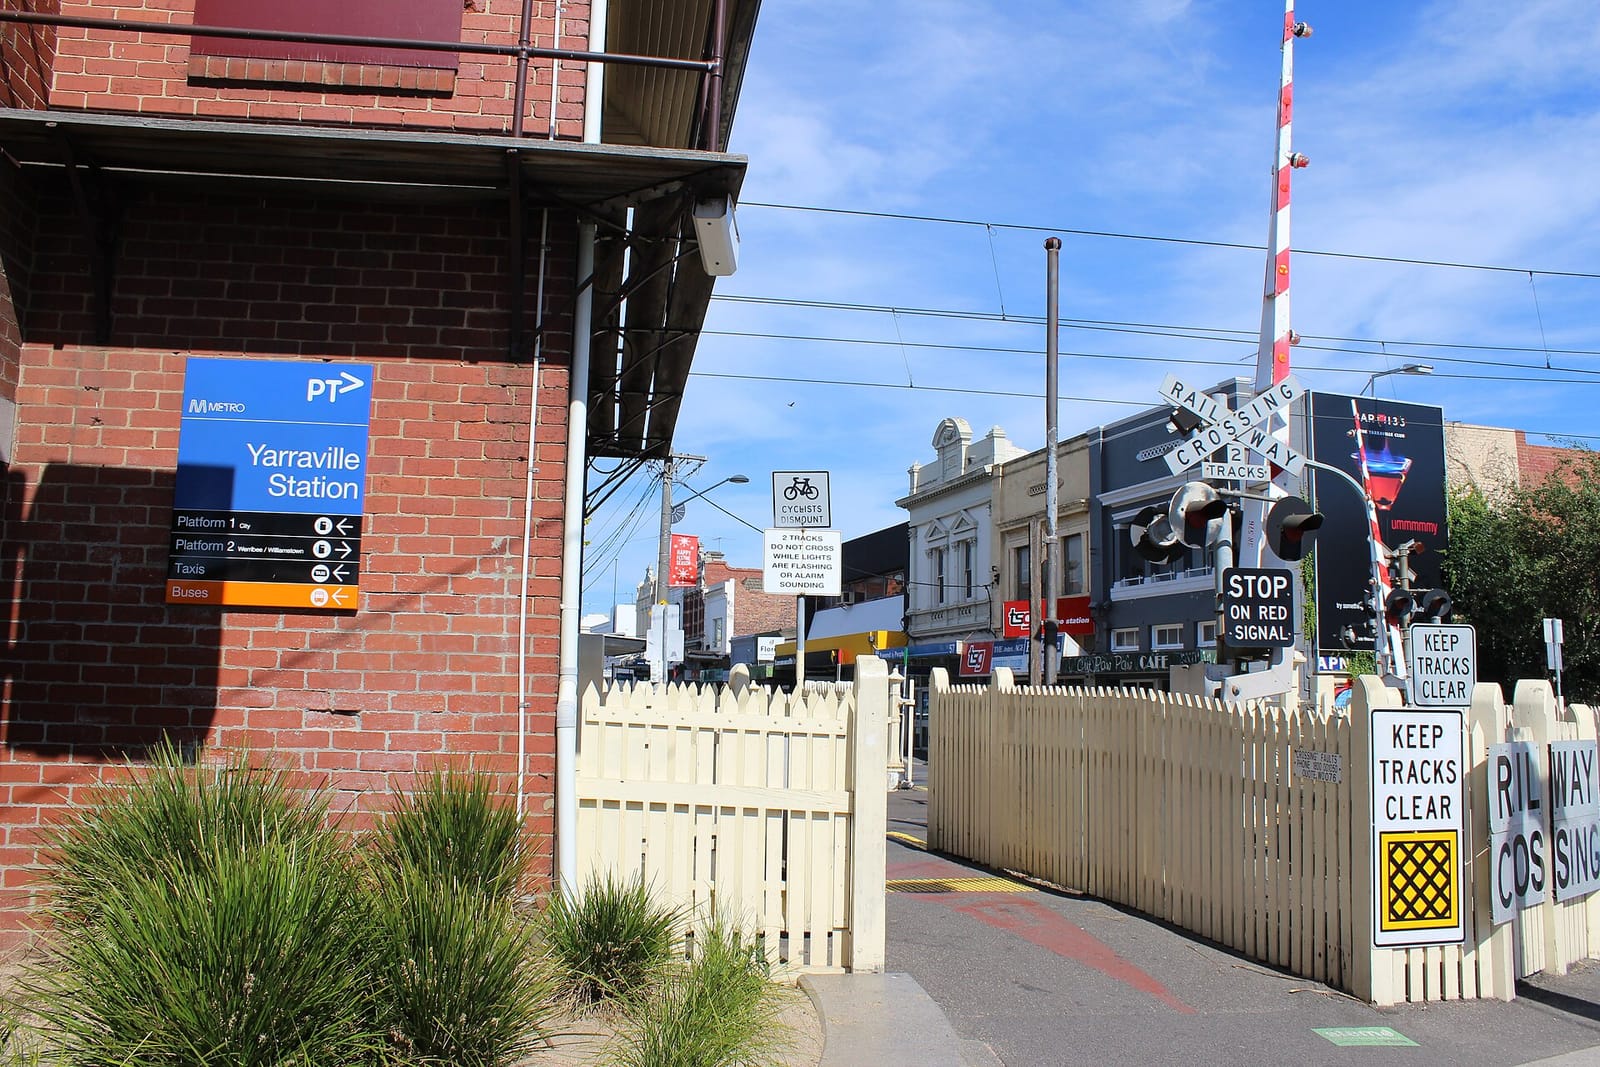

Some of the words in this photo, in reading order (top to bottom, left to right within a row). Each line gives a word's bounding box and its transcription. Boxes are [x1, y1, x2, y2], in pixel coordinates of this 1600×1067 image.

[307, 379, 342, 403] PT
[208, 402, 245, 413] METRO
[1170, 381, 1217, 422] RAIL
[1250, 430, 1297, 466] WAY
[1177, 384, 1293, 466] CROSSING
[247, 443, 361, 470] Yarraville
[1231, 448, 1241, 461] 2
[1208, 465, 1265, 478] TRACKS
[268, 474, 358, 500] Station
[782, 505, 822, 513] CYCLISTS
[177, 516, 226, 528] Platform
[229, 518, 235, 528] 1
[239, 522, 251, 530] City
[781, 516, 823, 524] DISMOUNT
[175, 539, 224, 552] Platform
[227, 541, 235, 552] 2
[175, 563, 205, 574] Taxis
[172, 587, 208, 598] Buses
[1229, 575, 1288, 598] STOP
[1230, 605, 1251, 620] ON
[1259, 605, 1288, 620] RED
[1235, 625, 1288, 640] SIGNAL
[1425, 633, 1459, 652] KEEP
[967, 645, 986, 672] tsg
[1418, 657, 1470, 675] TRACKS
[1423, 680, 1465, 699] CLEAR
[1393, 724, 1443, 748] KEEP
[1320, 754, 1338, 764] FAULTS
[1380, 760, 1457, 785] TRACKS
[1552, 750, 1592, 808] WAY
[1386, 796, 1451, 820] CLEAR
[1556, 823, 1600, 889] SING
